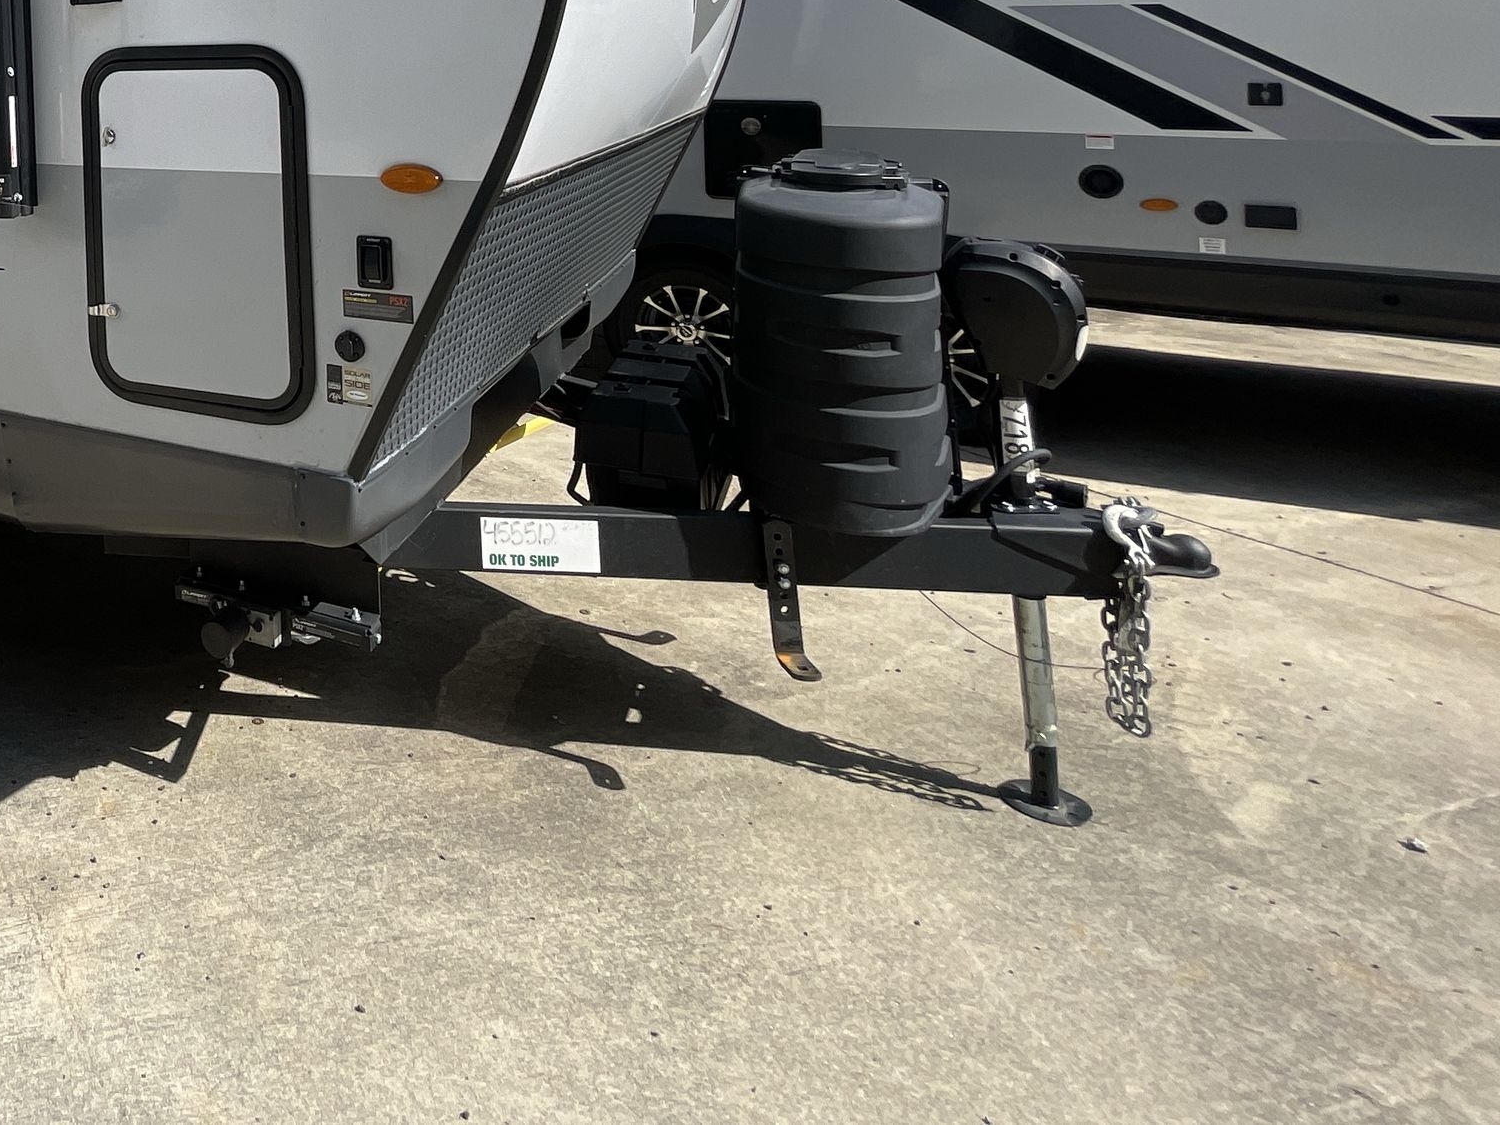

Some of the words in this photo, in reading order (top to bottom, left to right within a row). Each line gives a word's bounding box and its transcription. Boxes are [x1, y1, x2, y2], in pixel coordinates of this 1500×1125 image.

[388, 296, 409, 307] PSX2
[344, 369, 371, 379] SOLAR
[344, 379, 371, 391] SIDE
[489, 553, 507, 566] OK
[510, 554, 525, 566] TO
[529, 555, 560, 567] SHIP
